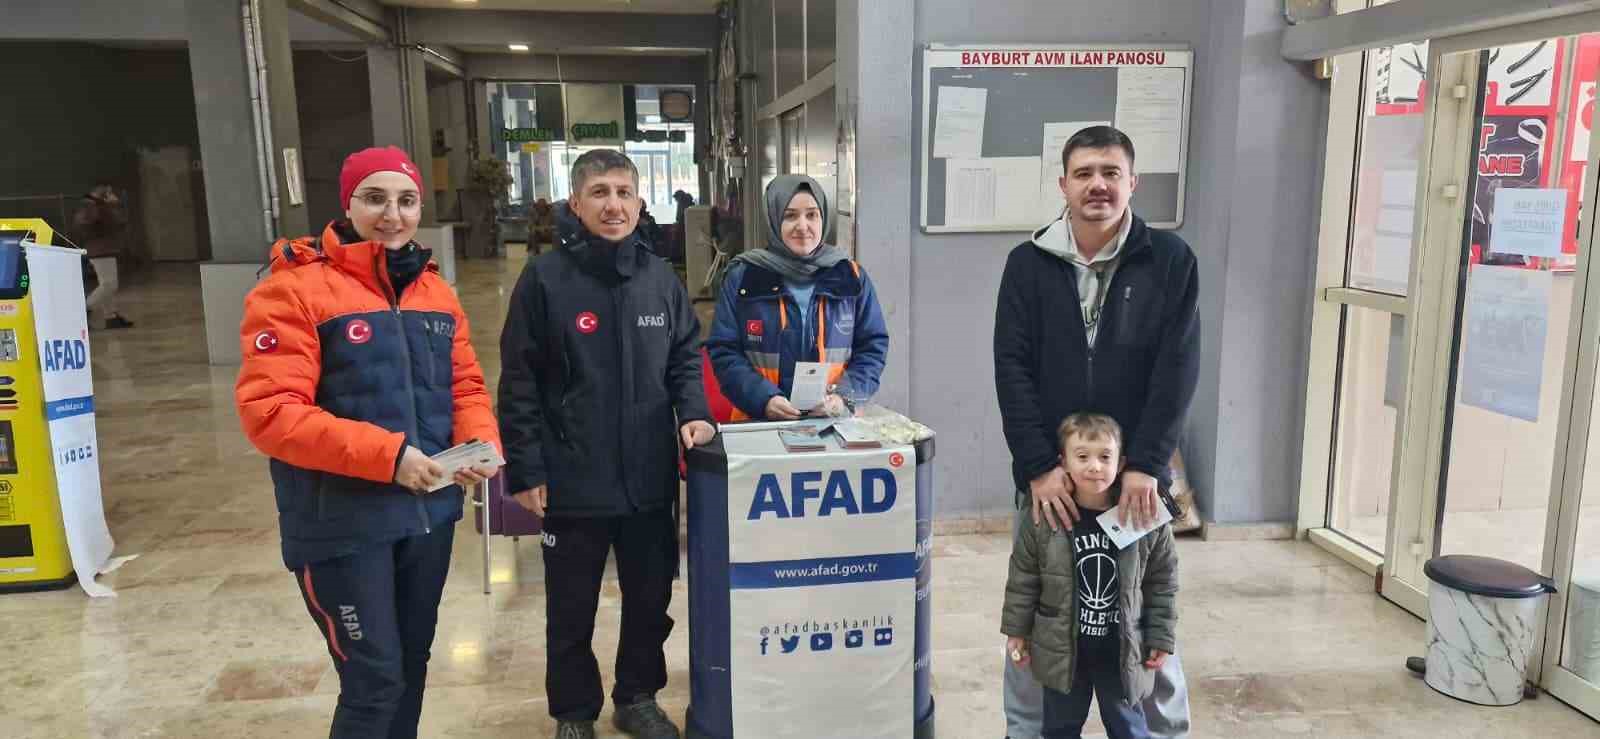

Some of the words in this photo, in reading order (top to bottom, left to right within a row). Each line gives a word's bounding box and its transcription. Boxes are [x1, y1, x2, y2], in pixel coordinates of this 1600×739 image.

[962, 52, 1030, 65] BAYBURT
[1034, 52, 1065, 65] AVM
[1107, 51, 1166, 65] PANOSU
[637, 315, 665, 328] AFAD
[44, 339, 86, 371] AFAD
[747, 468, 898, 520] AFAD
[774, 562, 879, 580] www.afad.gov.tr
[339, 604, 363, 641] AFAD
[760, 615, 894, 637] @afadbaskanlik
